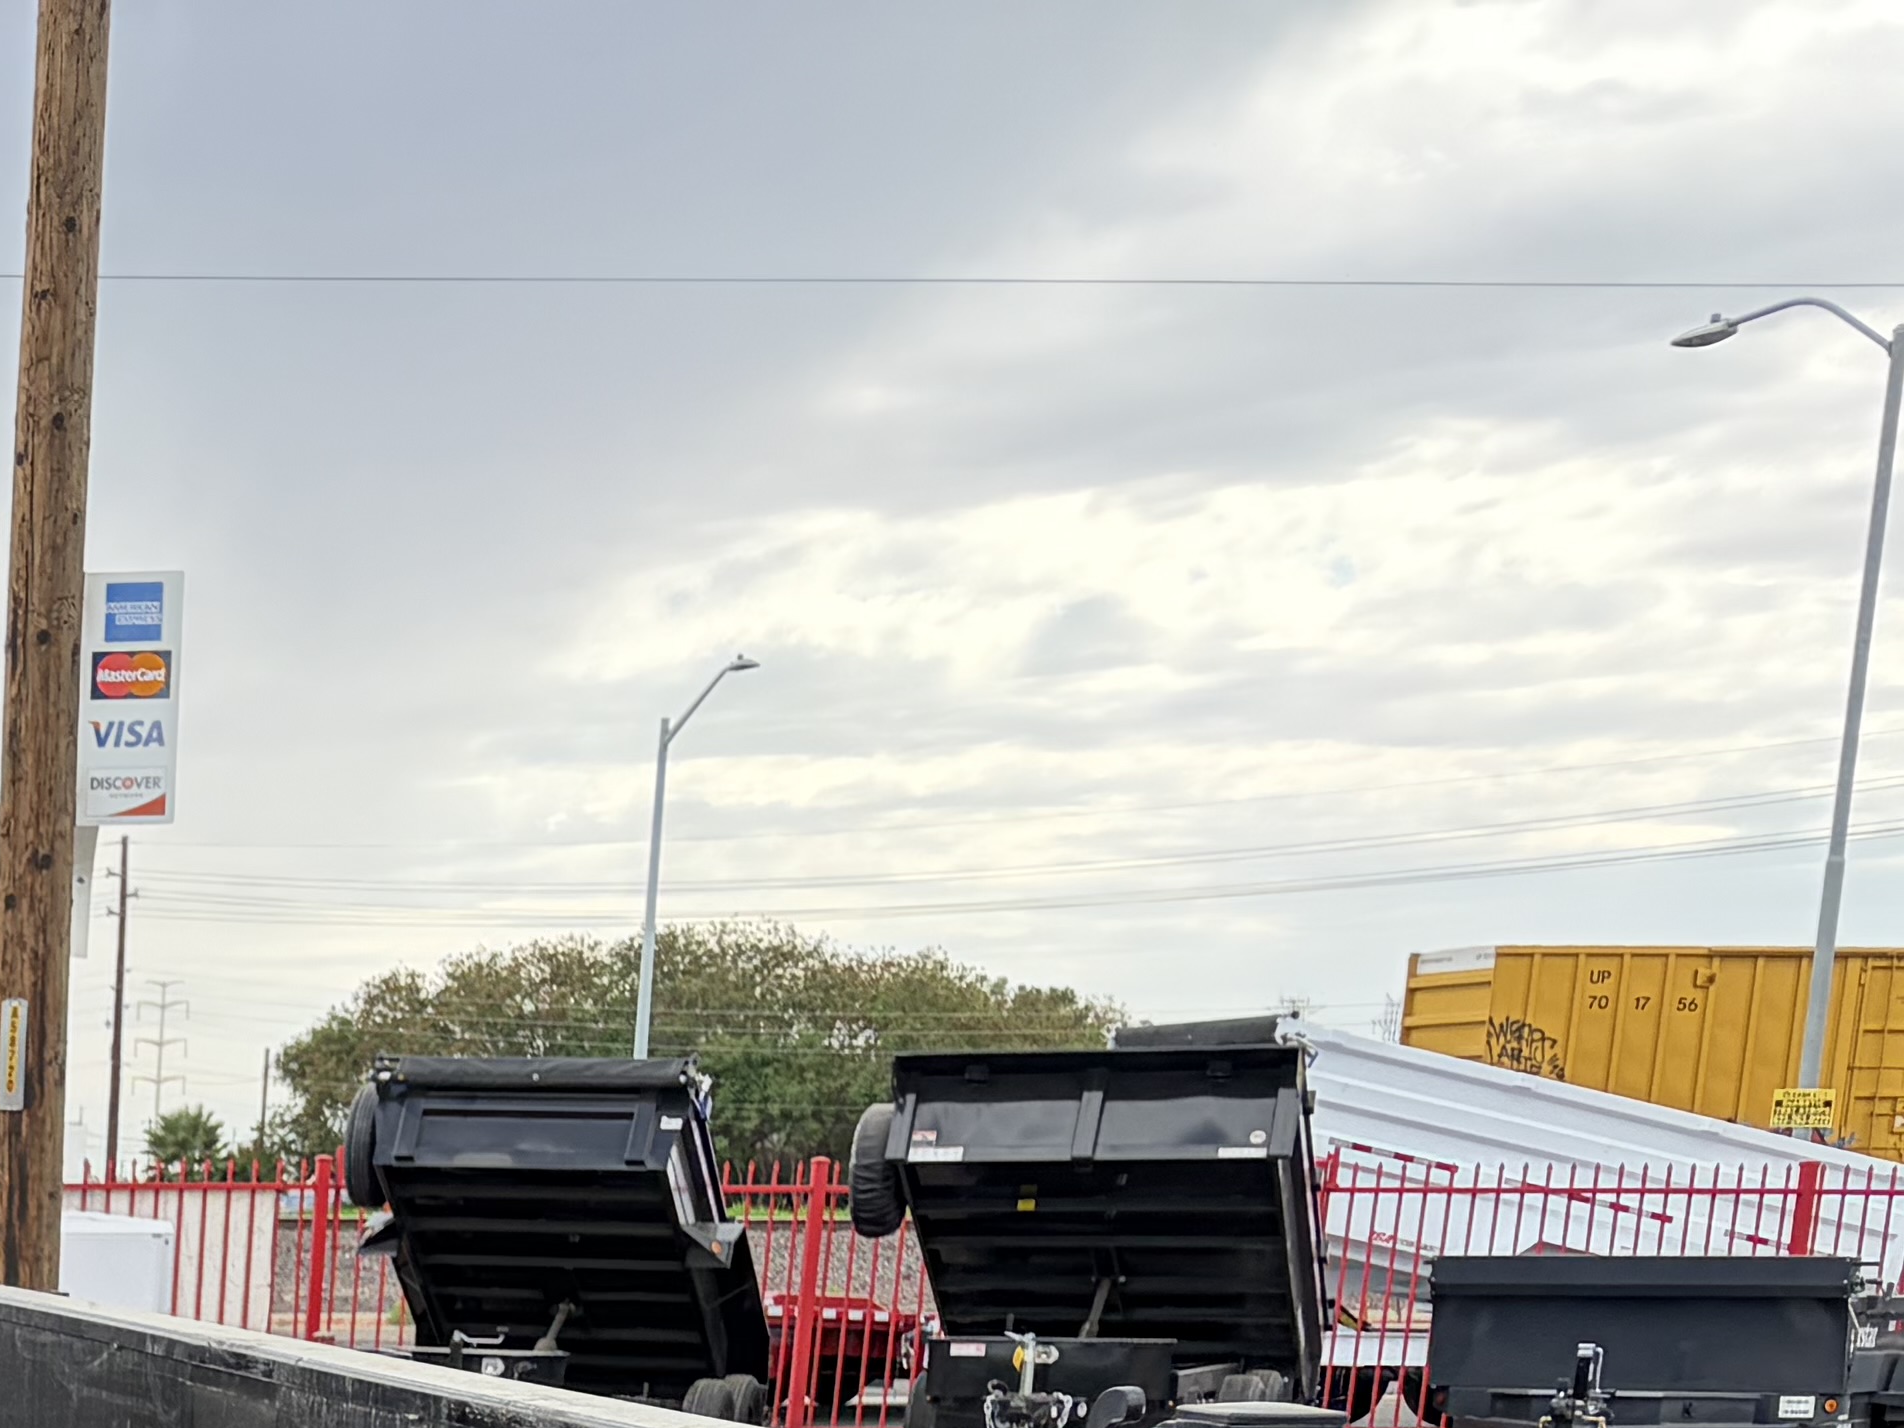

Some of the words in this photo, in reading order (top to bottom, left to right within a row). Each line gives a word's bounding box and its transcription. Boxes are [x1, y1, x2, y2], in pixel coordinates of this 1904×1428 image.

[88, 719, 165, 748] VISA
[90, 776, 162, 791] DISCOVER
[1589, 970, 1612, 984] UP
[1588, 995, 1609, 1010] 70
[1634, 996, 1651, 1010] 17
[1676, 997, 1699, 1012] 56
